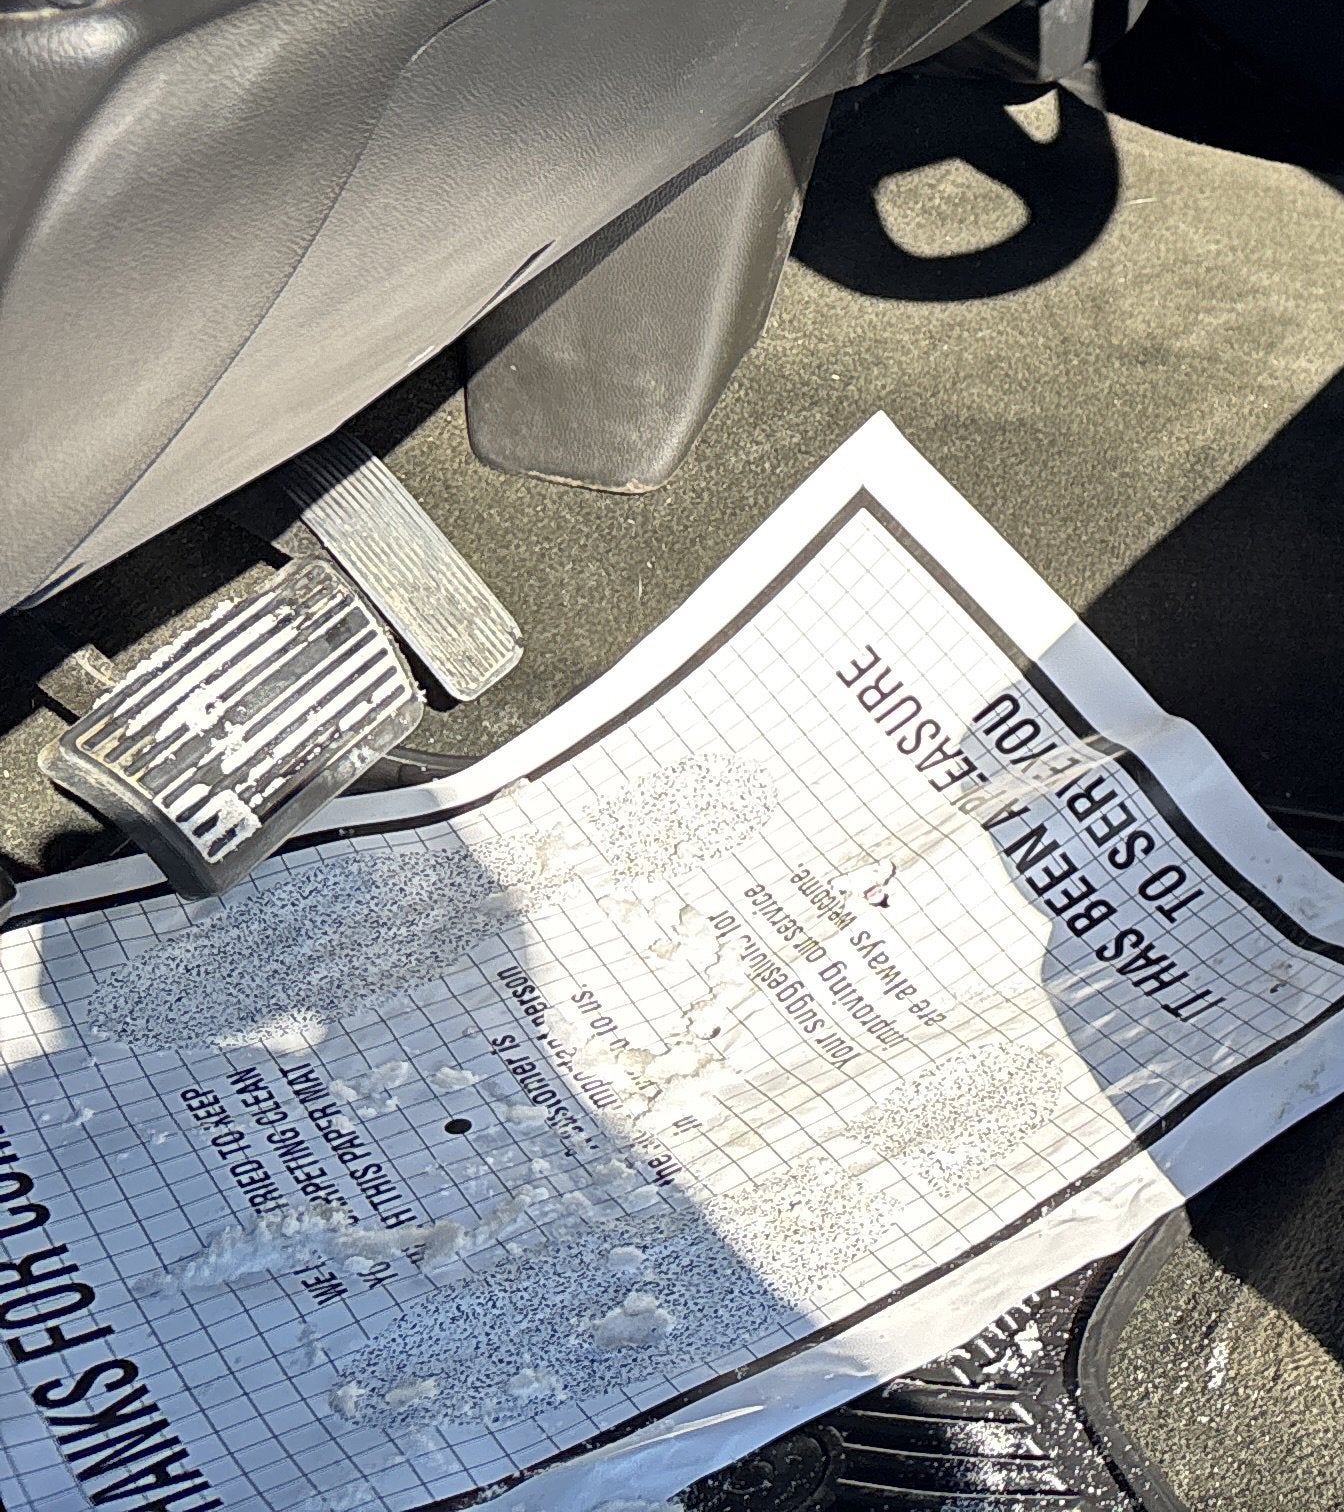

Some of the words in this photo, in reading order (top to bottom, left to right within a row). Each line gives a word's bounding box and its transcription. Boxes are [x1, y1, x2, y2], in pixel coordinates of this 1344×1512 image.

[834, 643, 1006, 815] PLEASURE
[971, 691, 1058, 773] YOU
[980, 796, 1030, 831] A
[1002, 822, 1118, 938] BEEN
[1137, 865, 1204, 924] TO
[743, 883, 803, 941] service
[792, 935, 825, 963] our
[848, 930, 917, 1001] always
[1096, 926, 1189, 996] HAS
[817, 960, 908, 1051] improving
[907, 998, 946, 1025] are
[1160, 989, 1225, 1022] IT
[489, 1033, 520, 1053] is
[813, 1031, 861, 1070] Your
[180, 1088, 234, 1131] KEEP
[226, 1064, 288, 1129] CLEAN
[279, 1061, 330, 1105] MAT
[210, 1128, 251, 1160] TO
[229, 1158, 289, 1214] TRIED
[266, 1126, 358, 1225] RPETING
[349, 1161, 402, 1210] THIS
[0, 1242, 116, 1364] FOR
[300, 1270, 348, 1305] WE
[30, 1356, 224, 1512] HANKS
